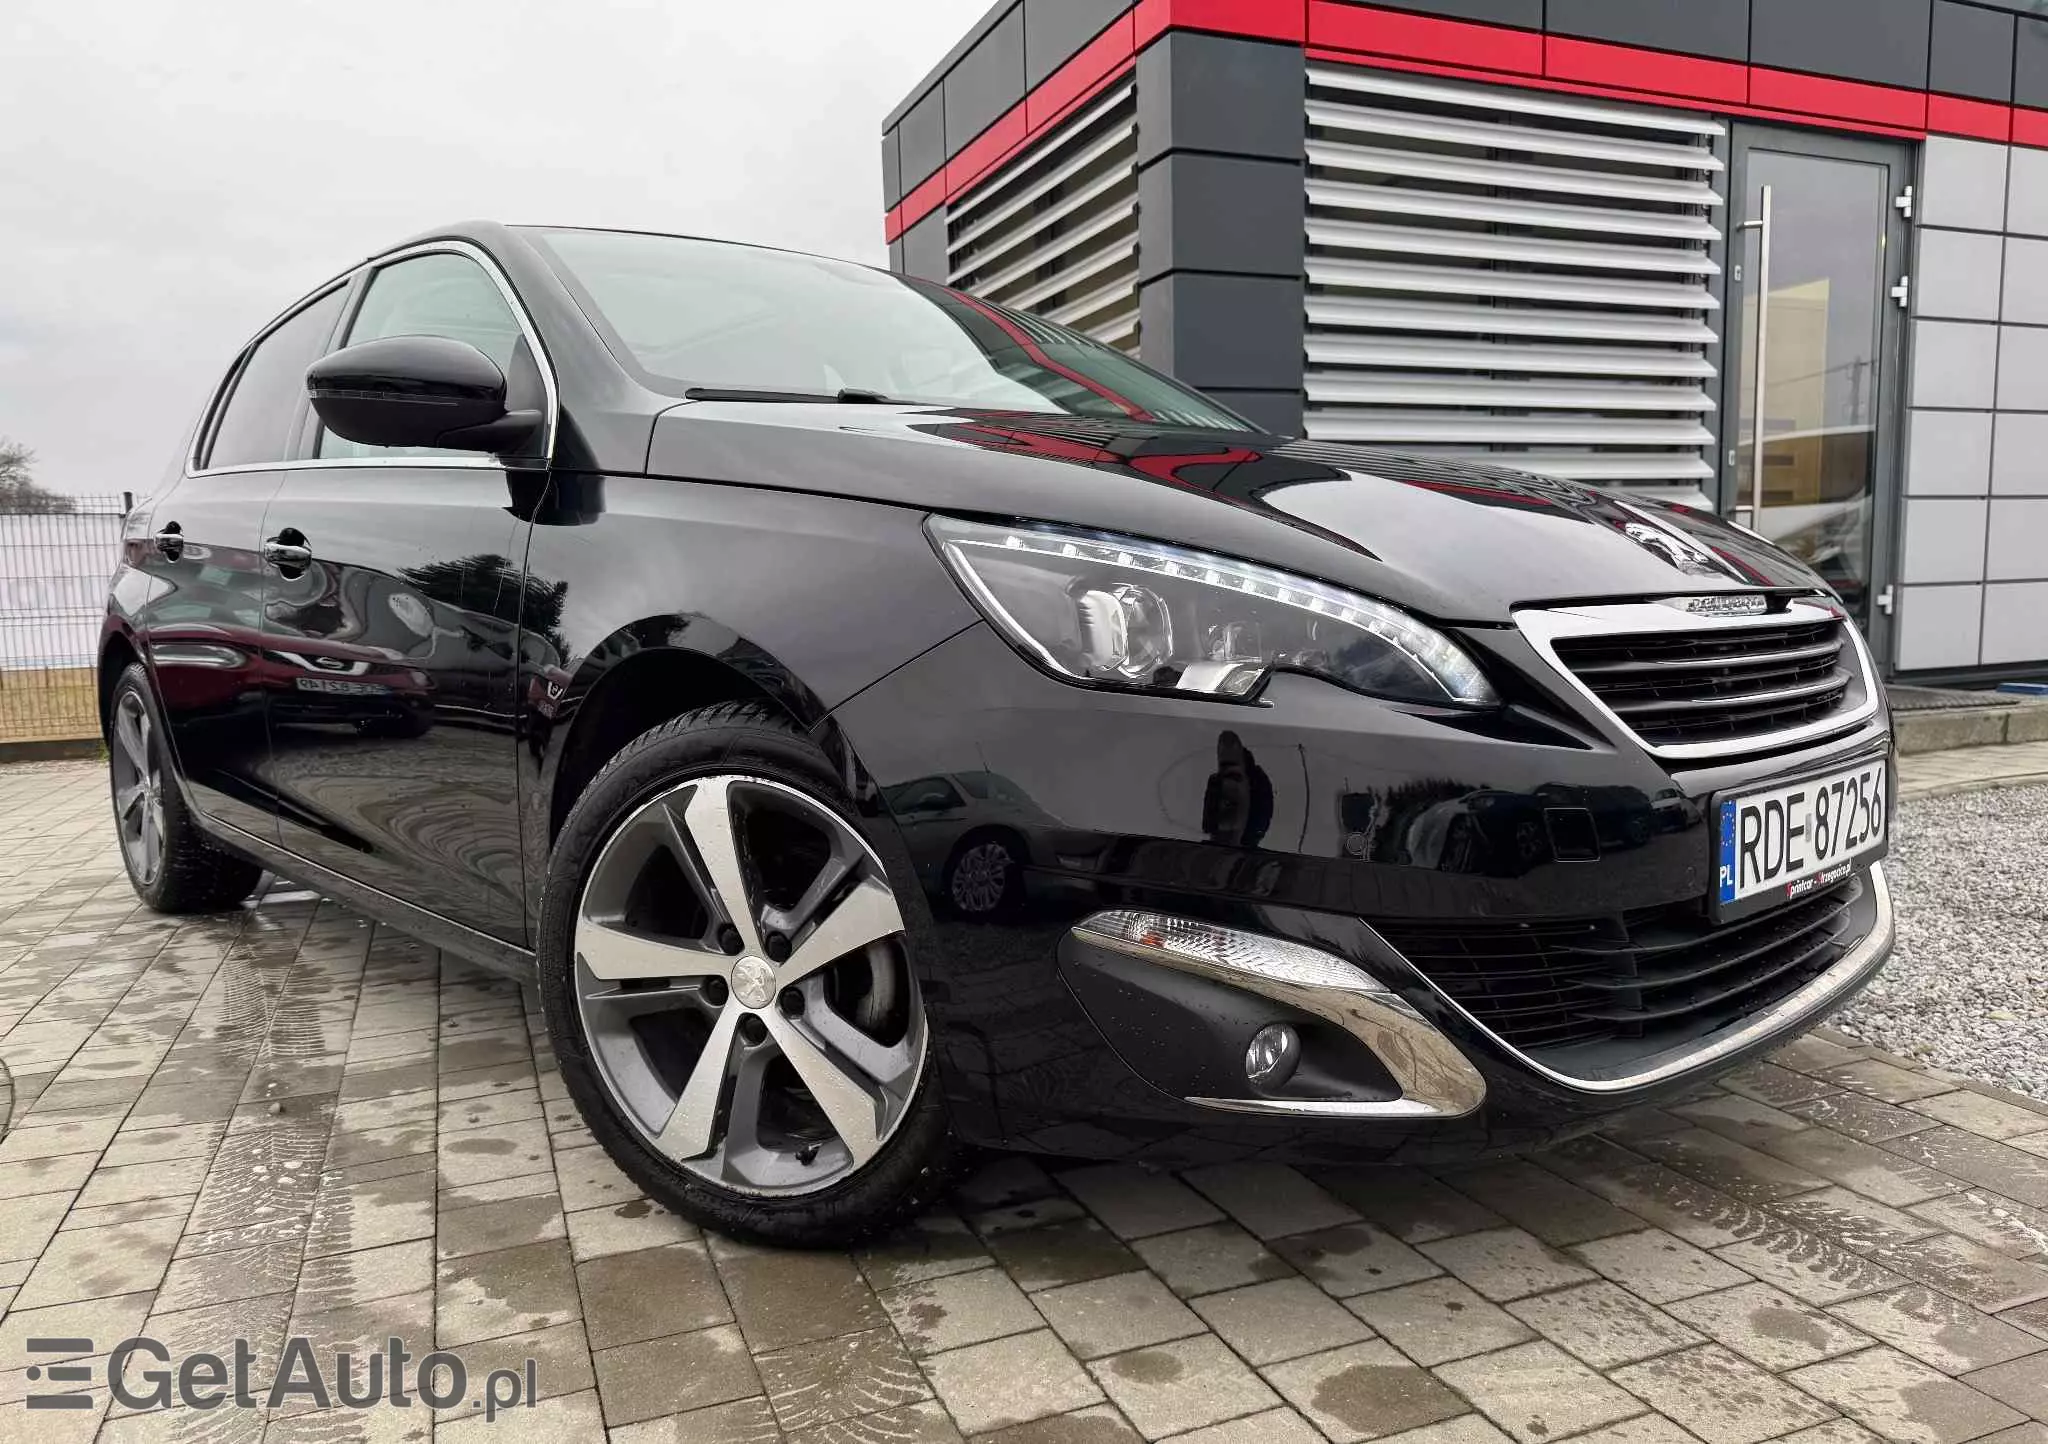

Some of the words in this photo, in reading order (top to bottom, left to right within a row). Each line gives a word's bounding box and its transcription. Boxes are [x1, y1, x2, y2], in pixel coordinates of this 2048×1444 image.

[1740, 792, 1804, 889] RDE
[1815, 767, 1882, 860] 87256
[1719, 865, 1733, 888] PL
